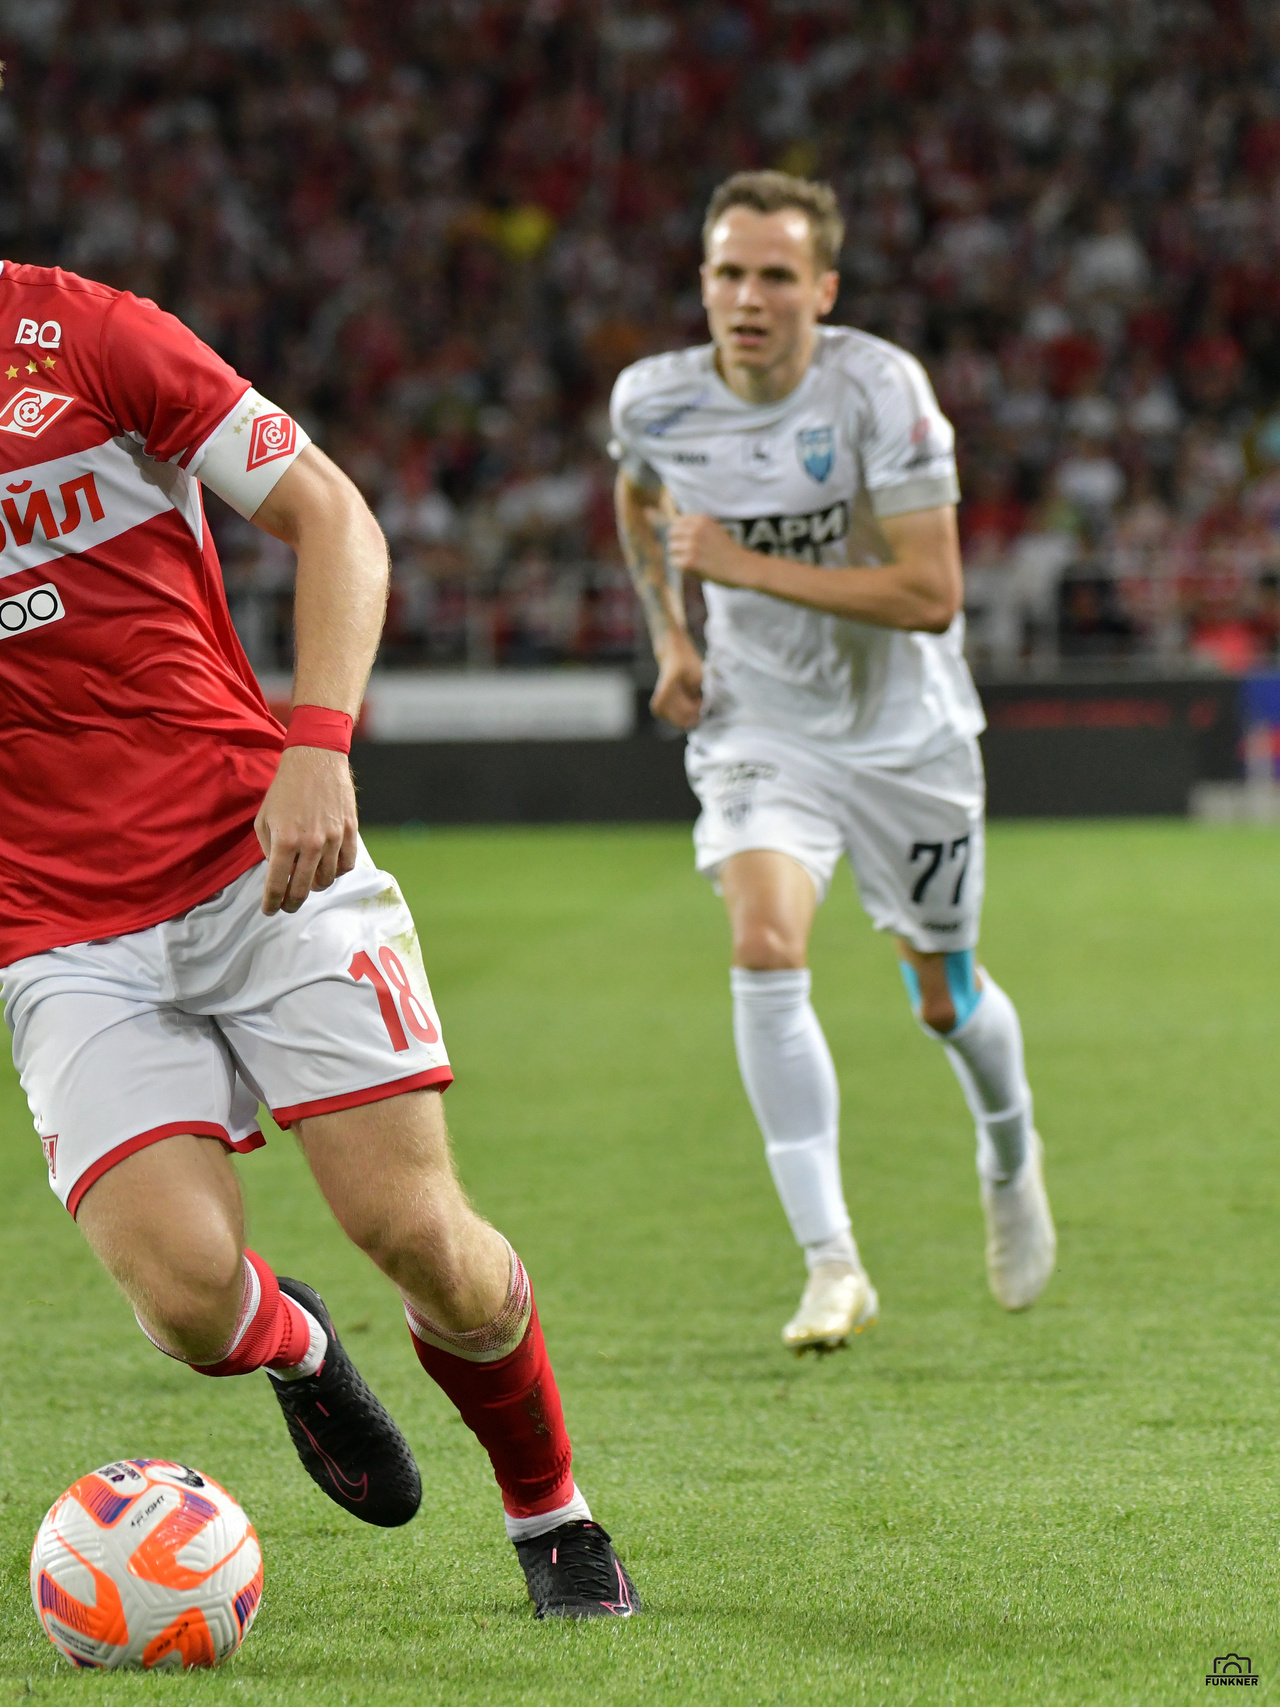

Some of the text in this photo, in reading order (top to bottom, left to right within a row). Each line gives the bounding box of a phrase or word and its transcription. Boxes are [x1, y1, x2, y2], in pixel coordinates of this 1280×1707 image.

[15, 318, 61, 348] BQ
[910, 835, 970, 906] 77
[348, 945, 438, 1052] 18
